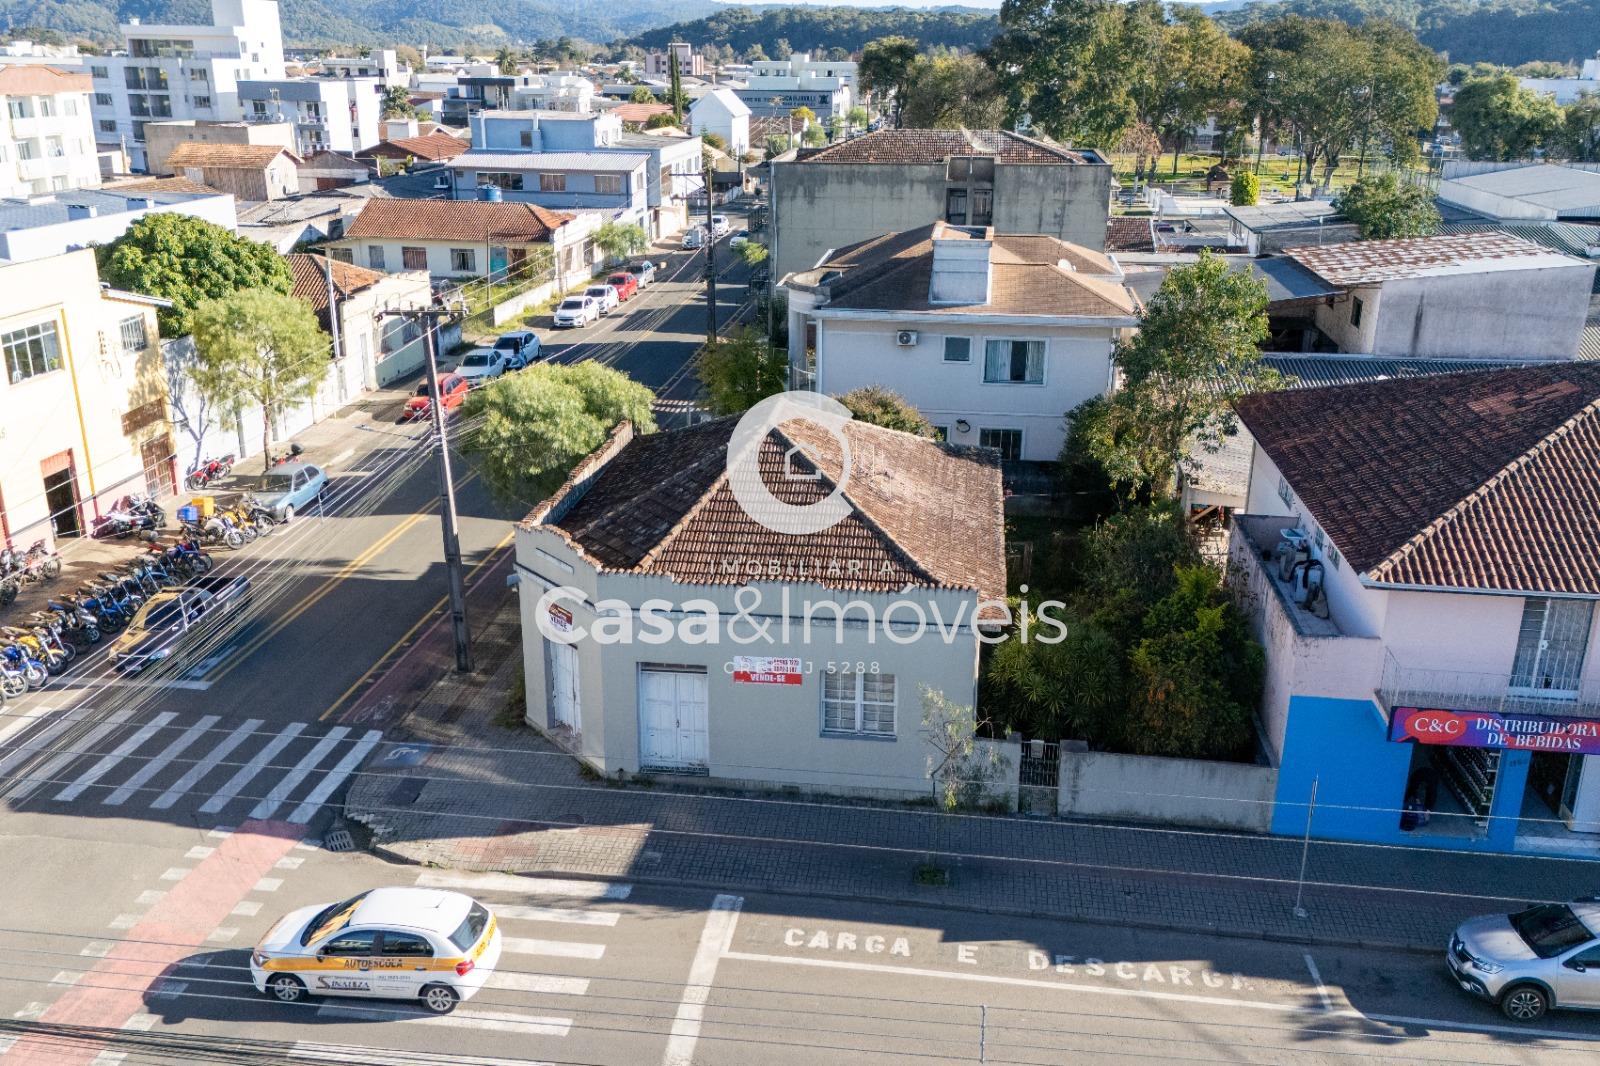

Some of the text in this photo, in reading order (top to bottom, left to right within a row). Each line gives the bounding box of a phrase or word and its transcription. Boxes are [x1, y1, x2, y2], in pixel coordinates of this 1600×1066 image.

[750, 673, 786, 683] VENDE-SE
[1413, 717, 1459, 734] C&C
[1476, 717, 1598, 737] DISTRIBUIDORA
[1487, 732, 1582, 750] DE BEBIDAS
[783, 928, 911, 957] CARGA
[957, 944, 978, 965] E
[344, 958, 403, 969] AUTOESCOLA
